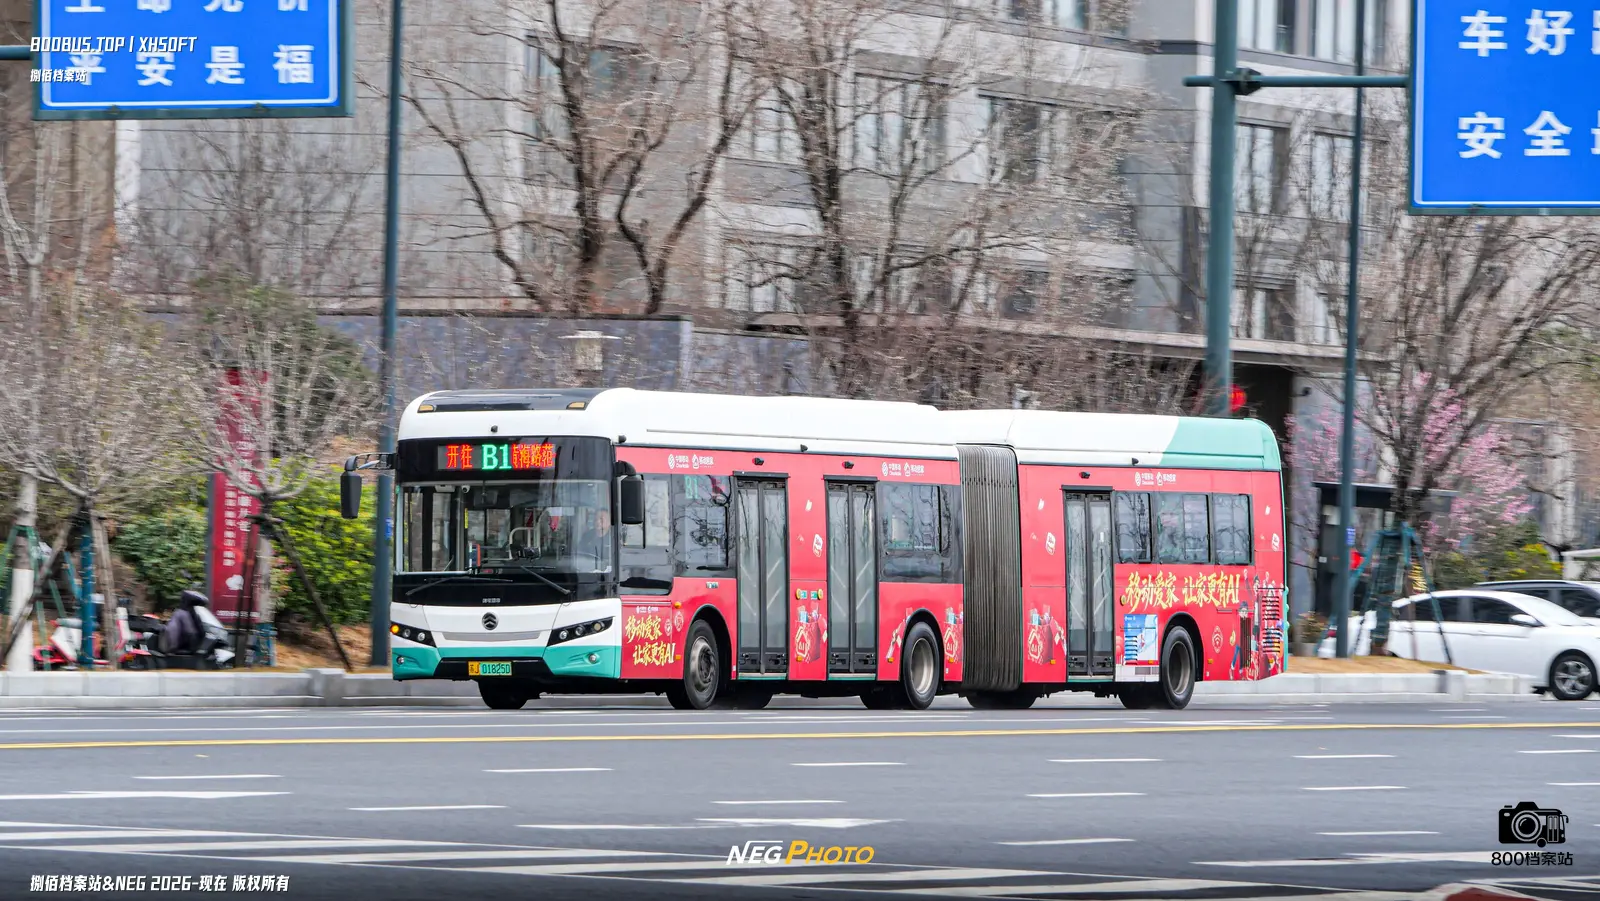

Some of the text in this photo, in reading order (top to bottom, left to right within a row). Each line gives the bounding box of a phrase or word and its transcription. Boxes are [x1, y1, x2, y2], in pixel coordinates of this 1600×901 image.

[1458, 9, 1600, 57] 车好
[1457, 110, 1600, 159] 安全
[446, 444, 473, 468] 开往
[482, 444, 512, 470] B1
